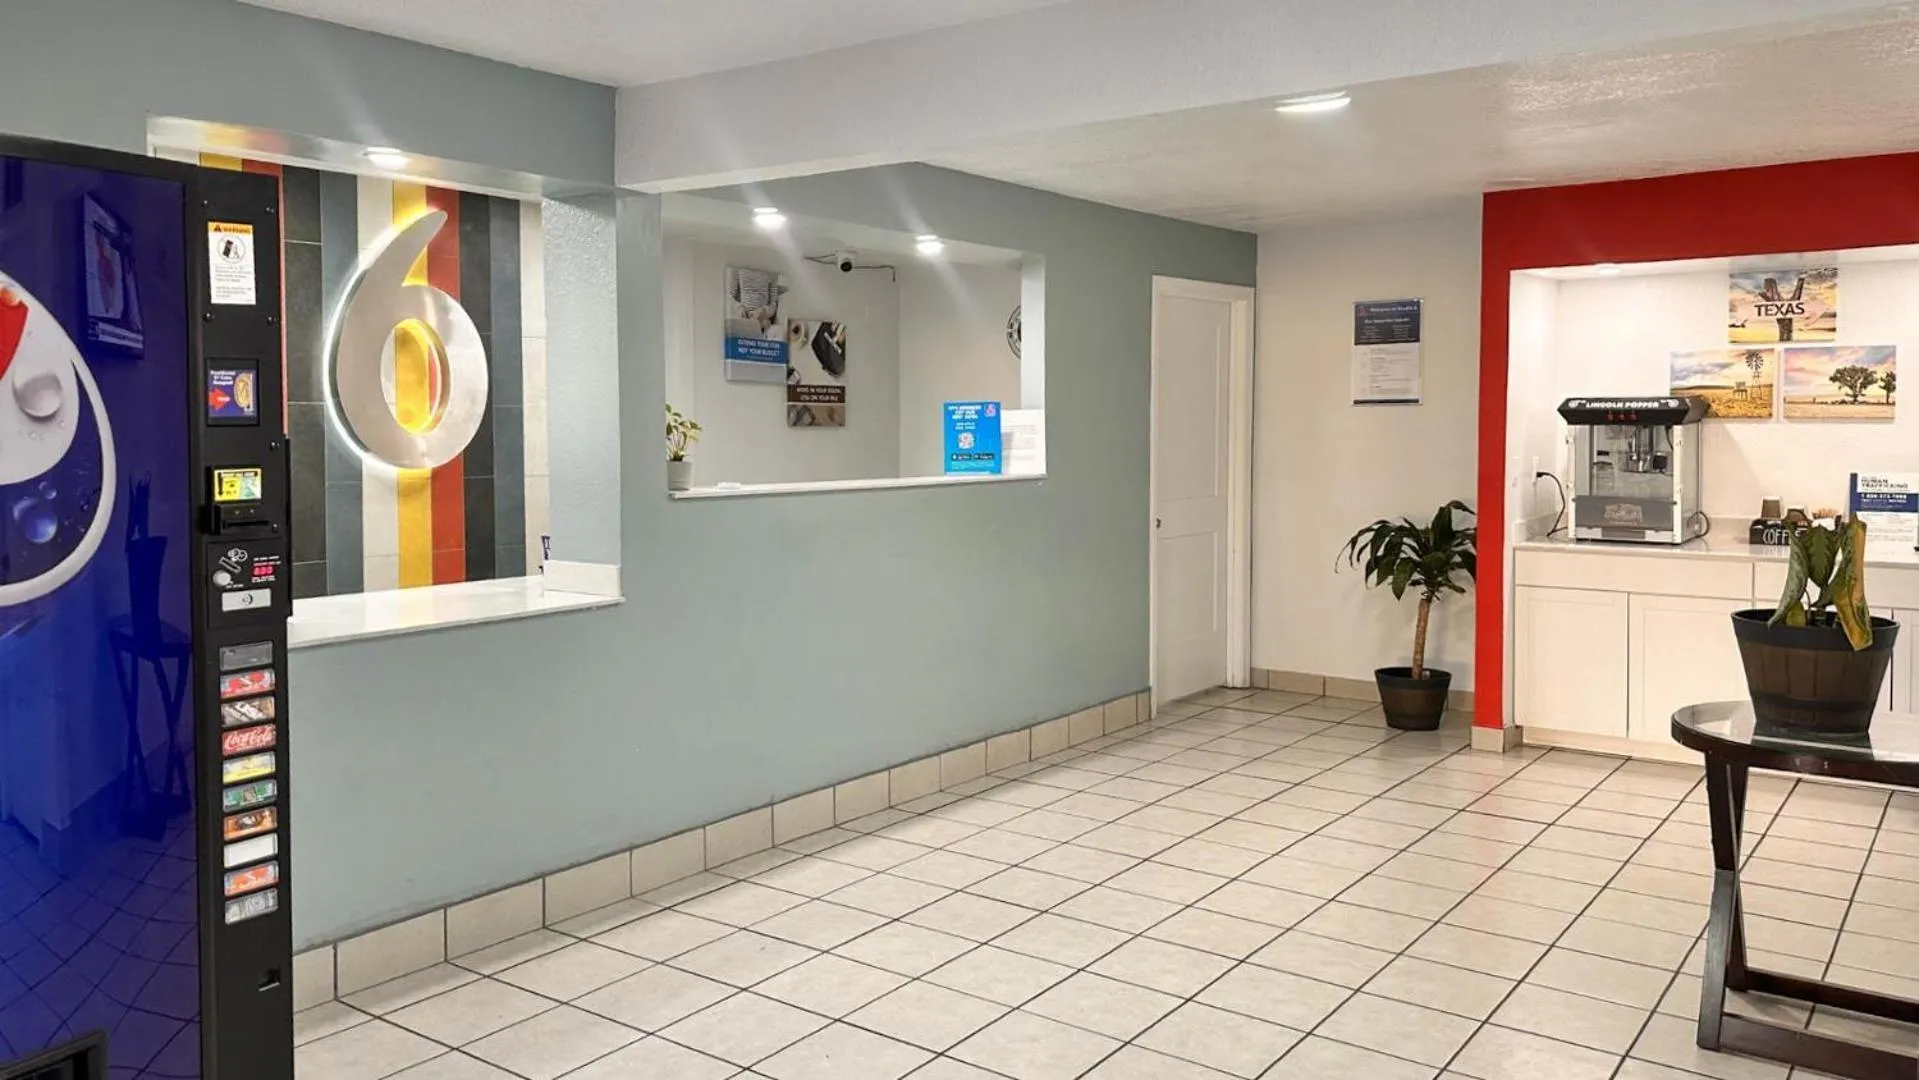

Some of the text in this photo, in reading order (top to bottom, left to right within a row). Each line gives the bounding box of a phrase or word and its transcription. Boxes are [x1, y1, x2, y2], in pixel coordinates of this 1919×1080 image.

[1754, 302, 1805, 317] TEXAS
[325, 208, 489, 470] 6
[1586, 401, 1660, 409] LINCOLN POPPER
